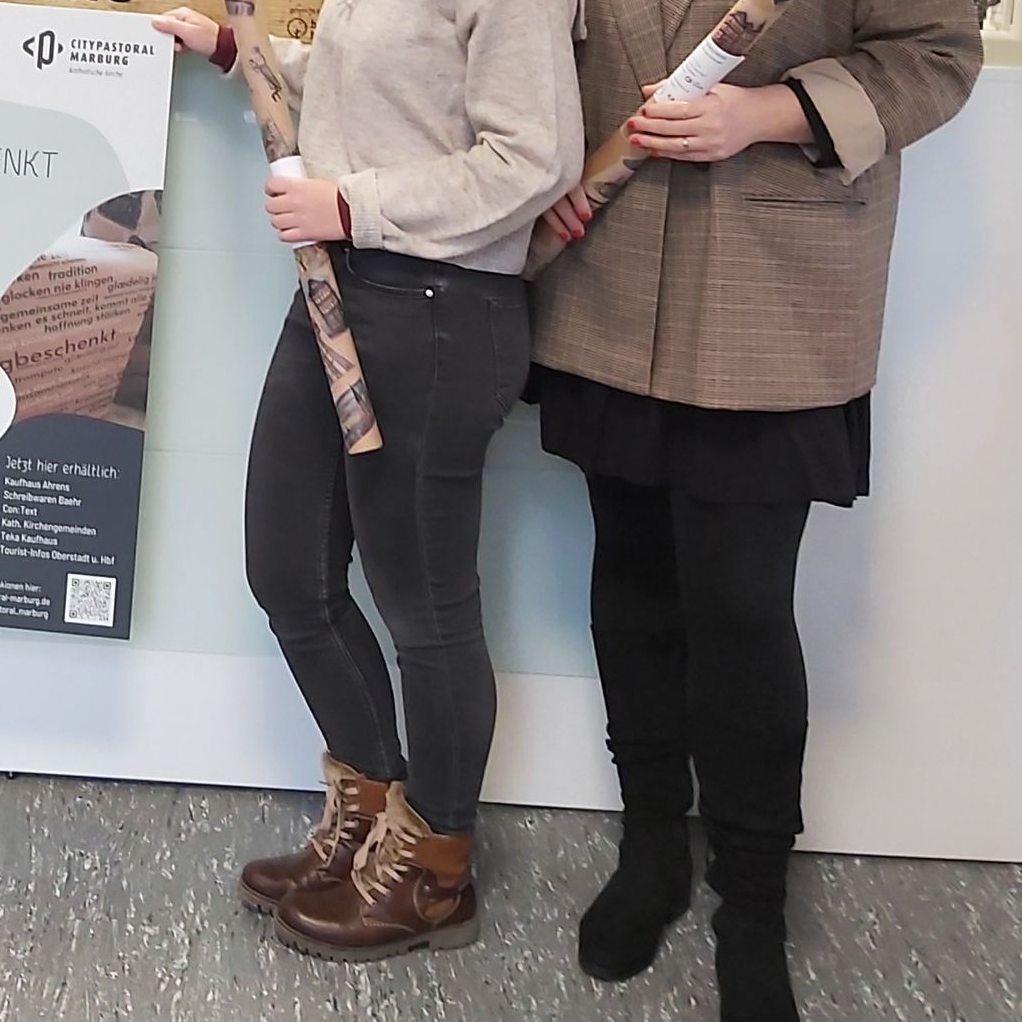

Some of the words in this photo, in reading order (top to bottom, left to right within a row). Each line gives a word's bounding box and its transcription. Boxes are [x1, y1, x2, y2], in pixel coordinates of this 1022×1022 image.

[70, 39, 155, 55] CITYPASTORAL
[69, 52, 129, 66] MARBURG
[48, 264, 98, 281] tradition
[1, 287, 51, 305] glocken
[54, 282, 72, 294] nie
[74, 275, 114, 291] klingen
[0, 299, 78, 324] gemeinsame
[80, 293, 99, 306] zeit
[35, 316, 48, 325] es
[94, 296, 129, 312] kommt
[44, 316, 94, 335] hoffnung
[5, 456, 33, 473] Jetzt
[36, 459, 59, 473] hier
[62, 463, 120, 479] erhältlich:
[4, 477, 41, 489] Kaufhaus
[42, 480, 70, 492] Ahrens
[3, 490, 57, 505] Schreibwaren
[58, 495, 82, 506] Baehr
[1, 518, 22, 529] Kath.
[23, 520, 96, 536] Kirchengemeinden
[1, 531, 20, 542] Teka
[21, 533, 58, 545] Kaufhaus
[0, 544, 50, 559] Tourist-Infos
[51, 549, 90, 563] Oberstadt
[100, 555, 115, 565] Hbf
